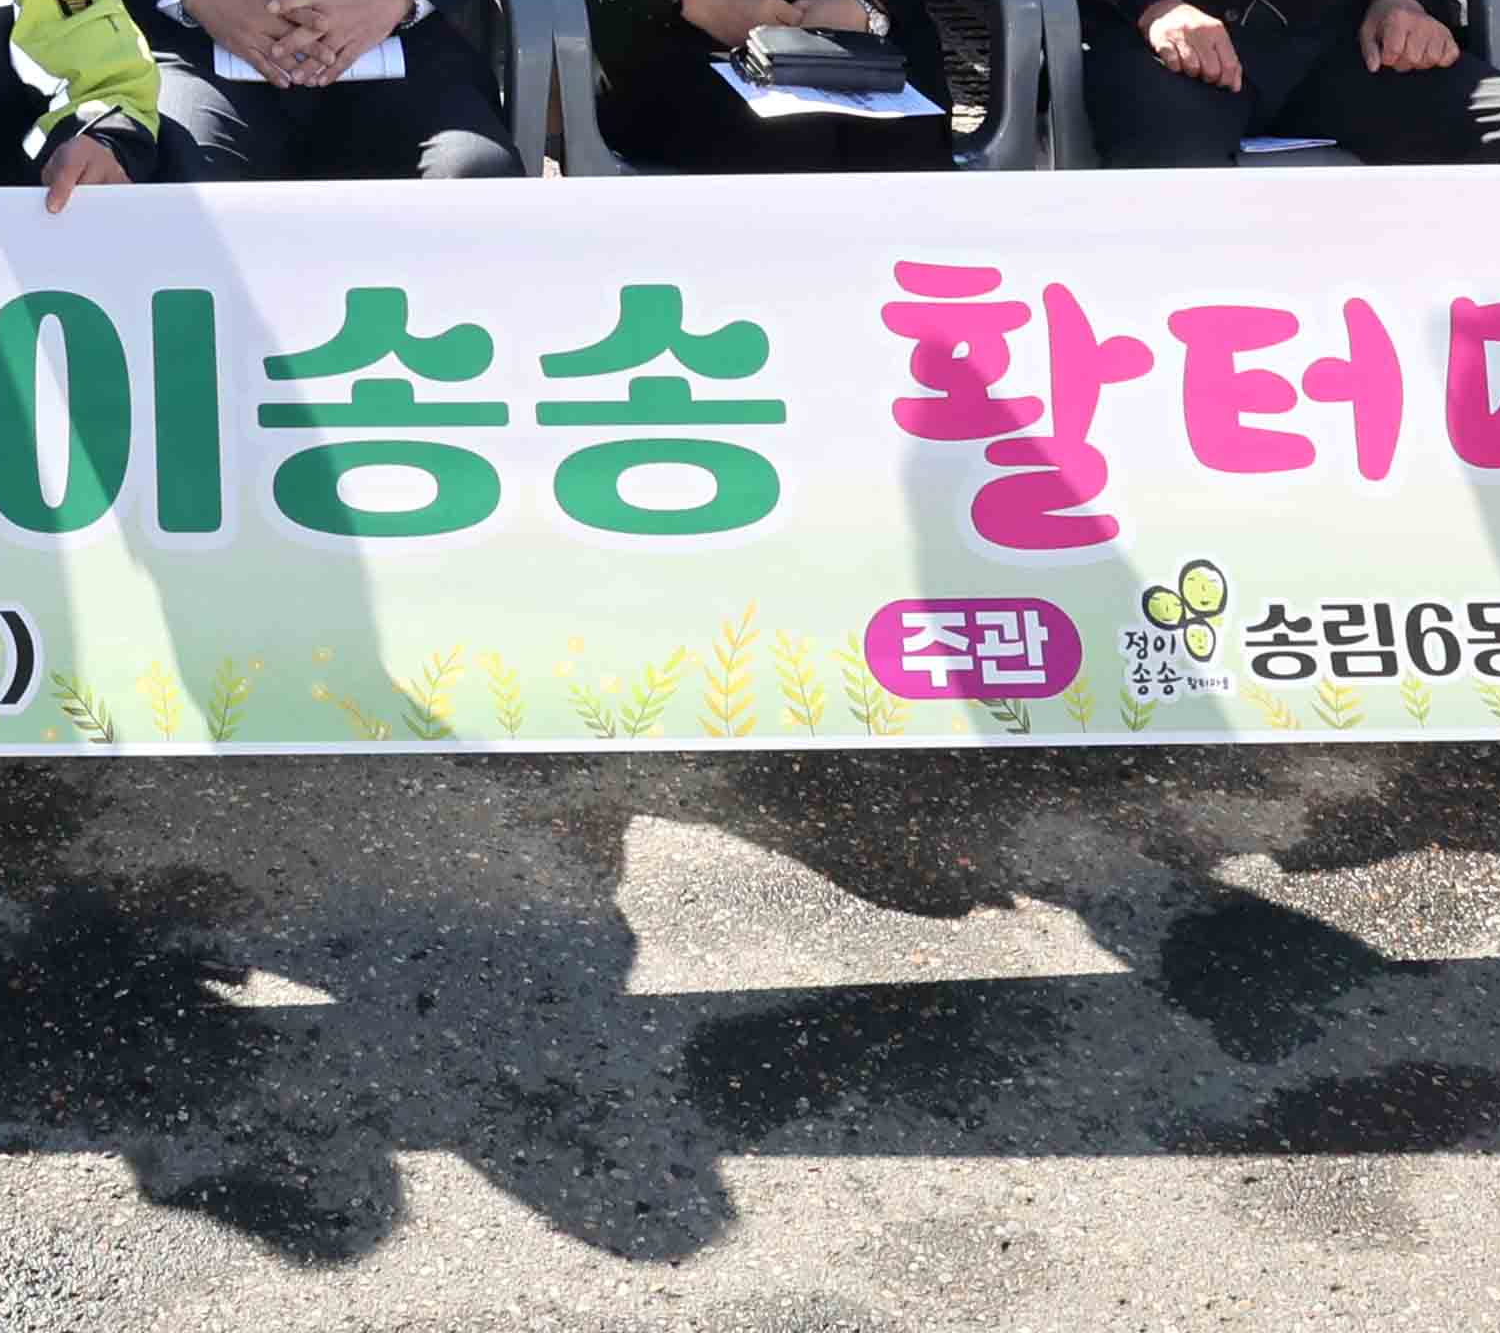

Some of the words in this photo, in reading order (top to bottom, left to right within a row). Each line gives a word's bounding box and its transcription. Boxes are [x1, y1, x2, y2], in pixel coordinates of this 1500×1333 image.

[902, 611, 1048, 687] 주관
[1125, 630, 1177, 660] 정이
[1132, 661, 1183, 695] 송송
